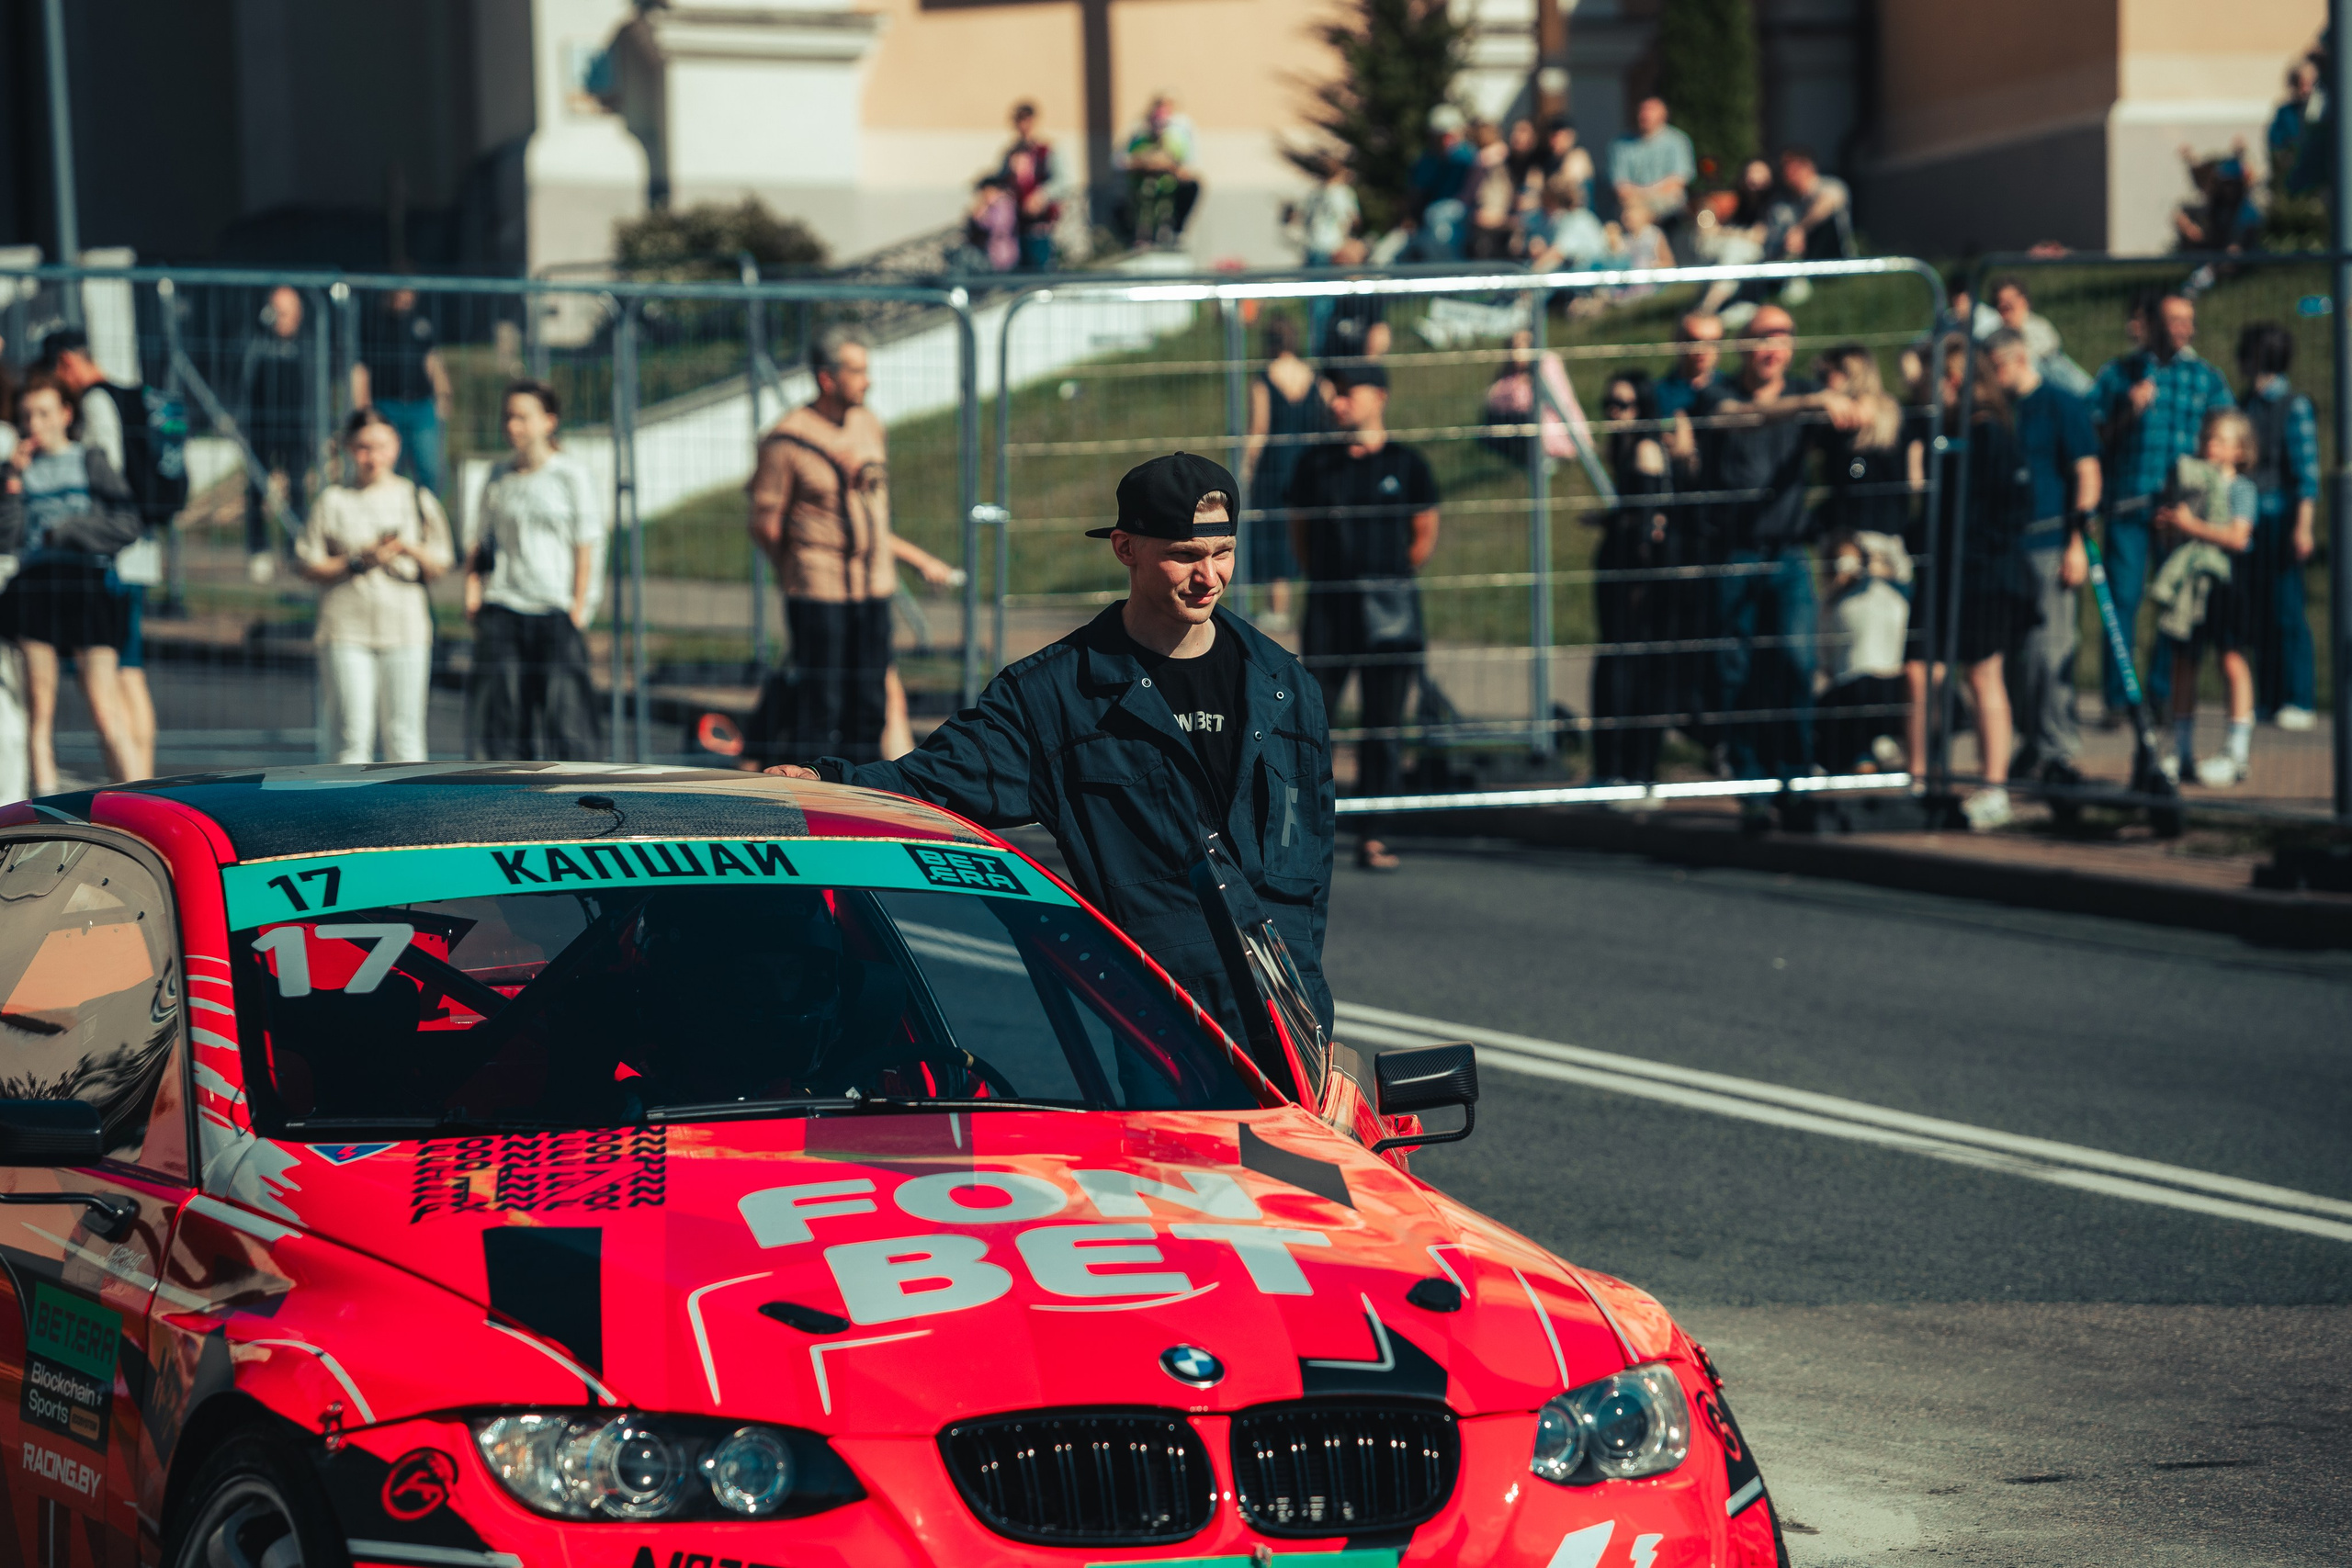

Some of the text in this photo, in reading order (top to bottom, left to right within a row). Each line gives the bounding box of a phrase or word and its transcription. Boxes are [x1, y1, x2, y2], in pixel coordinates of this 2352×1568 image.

[1173, 710, 1225, 732] NBET
[915, 849, 997, 873] BET
[929, 865, 1017, 889] ERA
[267, 865, 342, 911] 17
[251, 923, 415, 998] 17
[738, 1169, 1262, 1248] FON
[823, 1223, 1332, 1325] BET
[28, 1388, 69, 1424] Sports
[30, 1361, 96, 1406] Blockchain
[23, 1441, 102, 1497] RACING.BY
